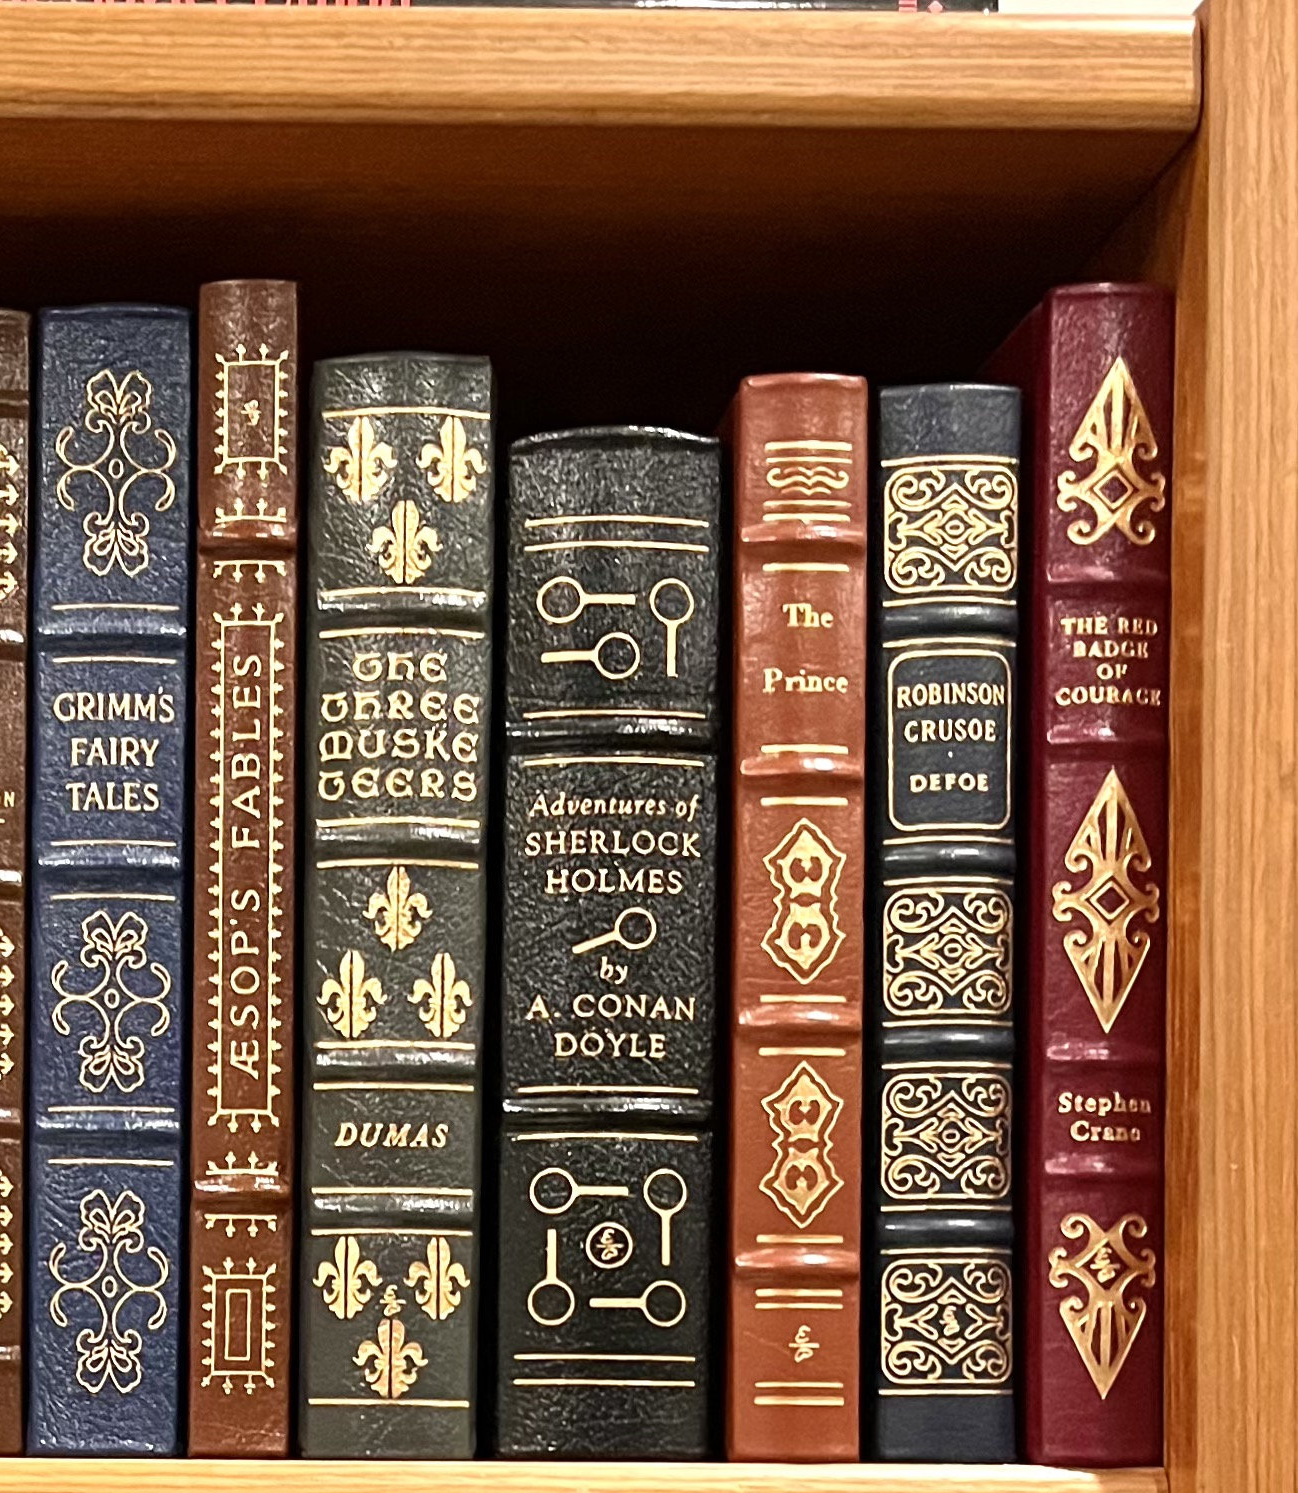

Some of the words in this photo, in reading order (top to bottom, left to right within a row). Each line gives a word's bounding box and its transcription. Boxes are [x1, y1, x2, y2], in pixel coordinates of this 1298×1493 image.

[782, 602, 835, 630] The
[1060, 616, 1108, 636] THE
[1117, 616, 1159, 637] RED
[1072, 639, 1150, 659] BADGE
[761, 667, 849, 695] Prince
[1095, 663, 1130, 681] OF
[52, 685, 176, 724] GRIMM'S
[895, 681, 1006, 710] ROBINSON
[1054, 686, 1163, 708] COURAGE
[903, 717, 998, 744] CRUSOE
[69, 736, 160, 768] FAIRY
[230, 654, 263, 850] FABLES
[65, 781, 161, 812] TALES
[908, 772, 990, 794] DEFOE
[528, 791, 667, 818] Adventures
[674, 793, 700, 823] of
[524, 829, 702, 858] SHERLOCK
[544, 867, 684, 895] HOLMES
[599, 955, 629, 985] by
[229, 888, 262, 1081] ÆSOP'S
[524, 993, 562, 1021] A.
[571, 993, 697, 1022] CONAN
[553, 1031, 668, 1059] DOYLE
[1057, 1090, 1152, 1118] Stephen
[333, 1121, 450, 1149] DUMAS
